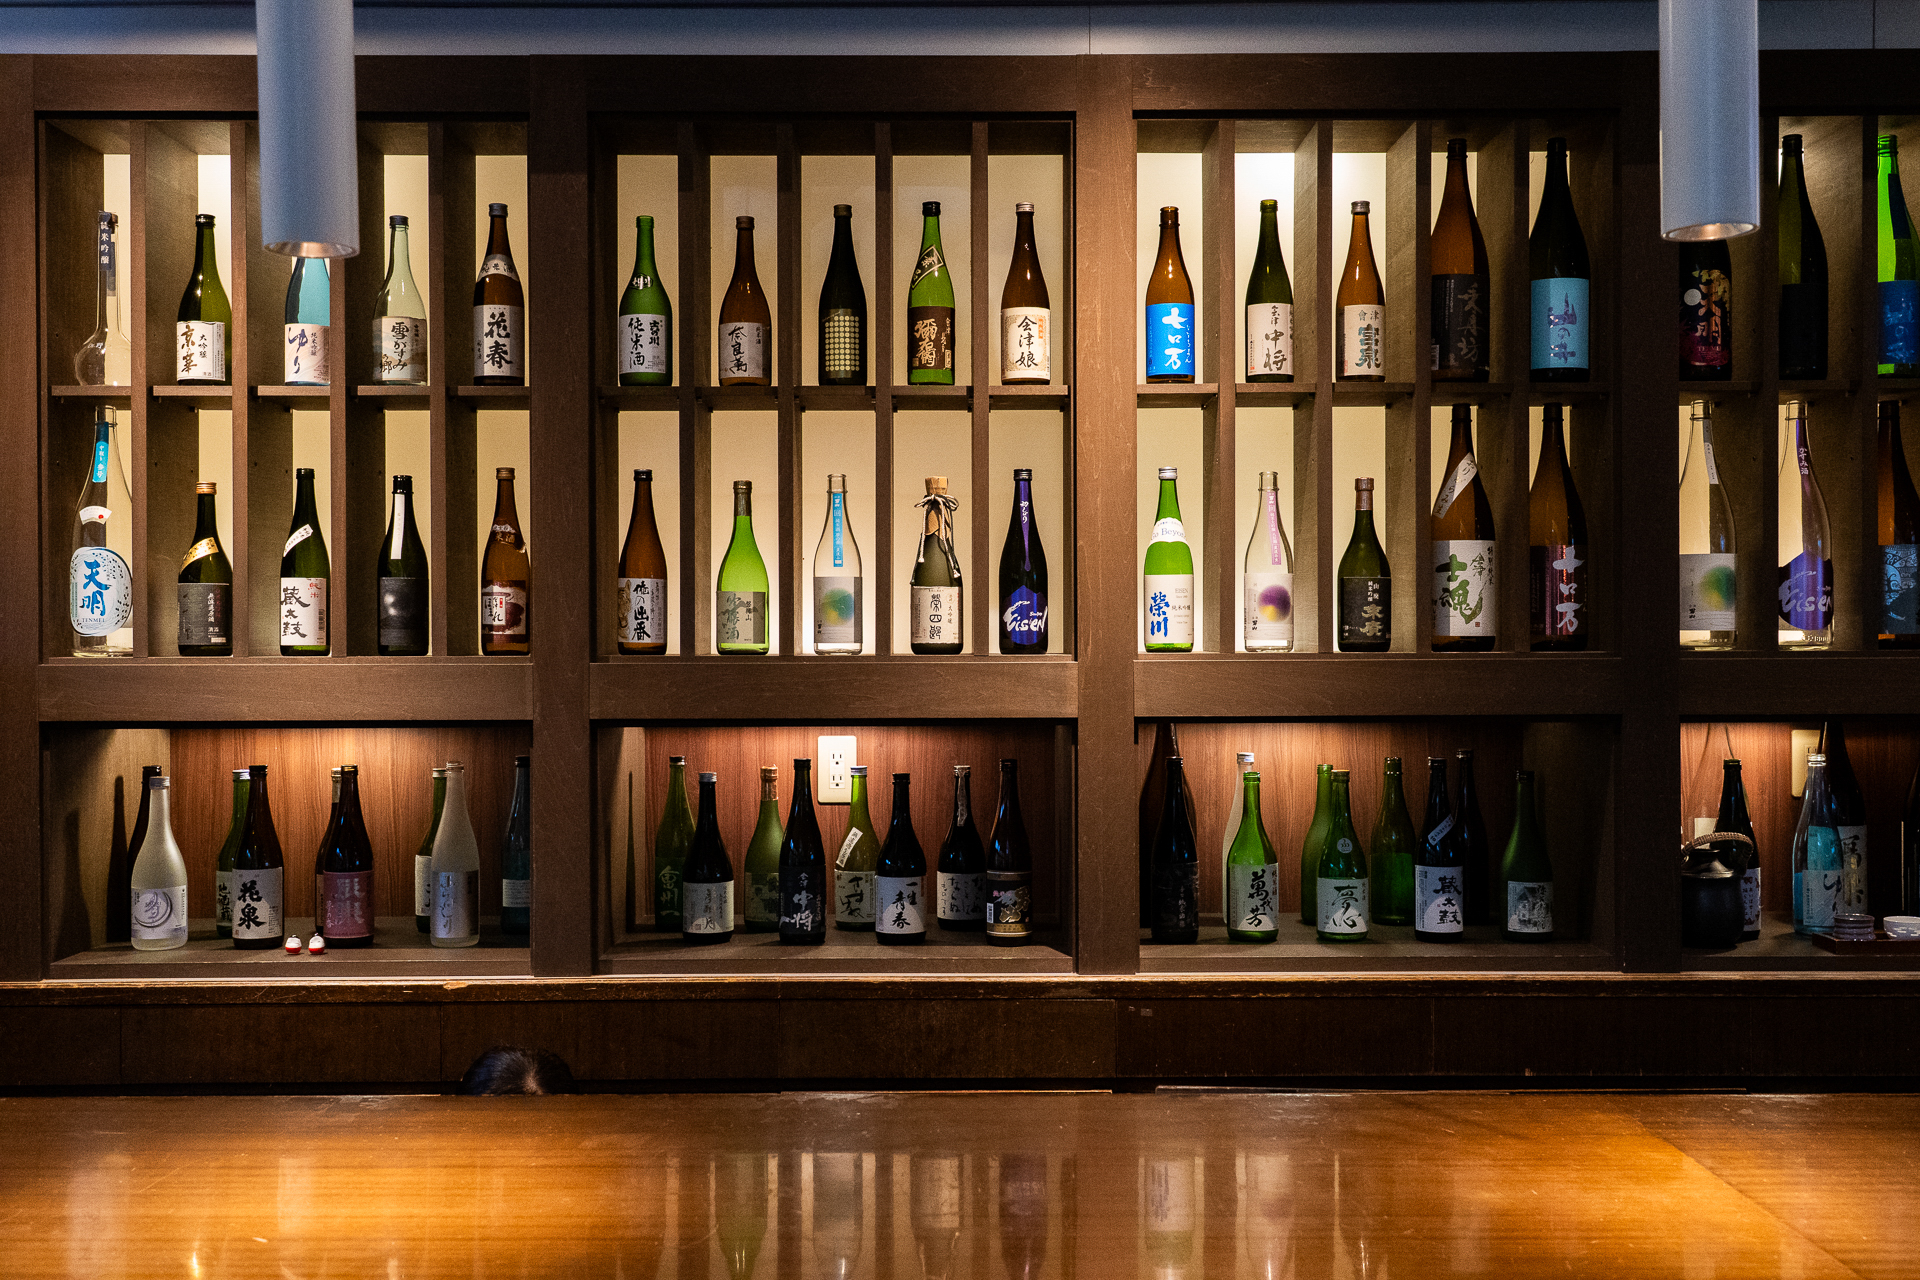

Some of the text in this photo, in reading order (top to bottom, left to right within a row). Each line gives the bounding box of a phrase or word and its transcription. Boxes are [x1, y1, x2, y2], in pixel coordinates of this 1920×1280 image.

[288, 327, 309, 375] ゆり
[310, 332, 318, 357] 純米吟醸
[483, 311, 514, 369] 花春
[628, 317, 645, 369] 純米酒
[1015, 316, 1038, 368] 会津娘
[1355, 323, 1381, 369] 宮泉
[79, 559, 112, 617] 天明
[280, 586, 311, 639] 蔵太鼓
[633, 580, 651, 641] 俺の出番
[237, 879, 268, 930] 花泉
[892, 890, 911, 929] 青春
[905, 881, 918, 906] 一生
[1331, 884, 1362, 929] 夢心
[1433, 875, 1463, 926] 蔵太鼓
